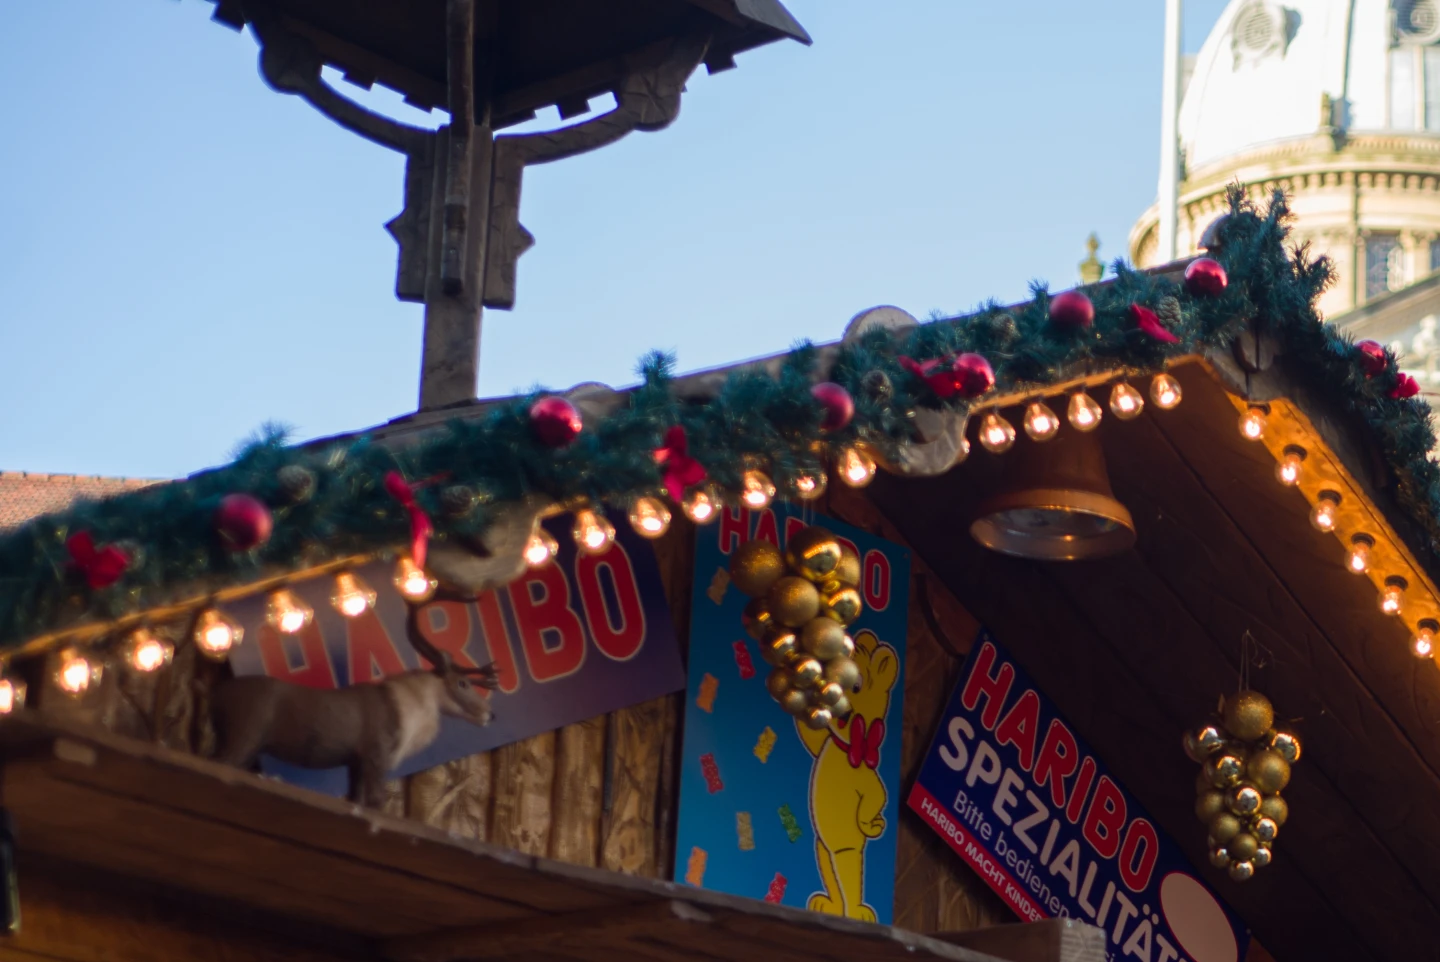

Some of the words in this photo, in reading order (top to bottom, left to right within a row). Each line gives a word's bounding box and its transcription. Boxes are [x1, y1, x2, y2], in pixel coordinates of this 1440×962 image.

[718, 493, 892, 612] HAO
[257, 538, 647, 702] HARIBO
[953, 790, 992, 841] Bitte
[961, 640, 1159, 893] HARIBO
[921, 797, 965, 846] HARIBO
[964, 841, 1006, 887] MACHT
